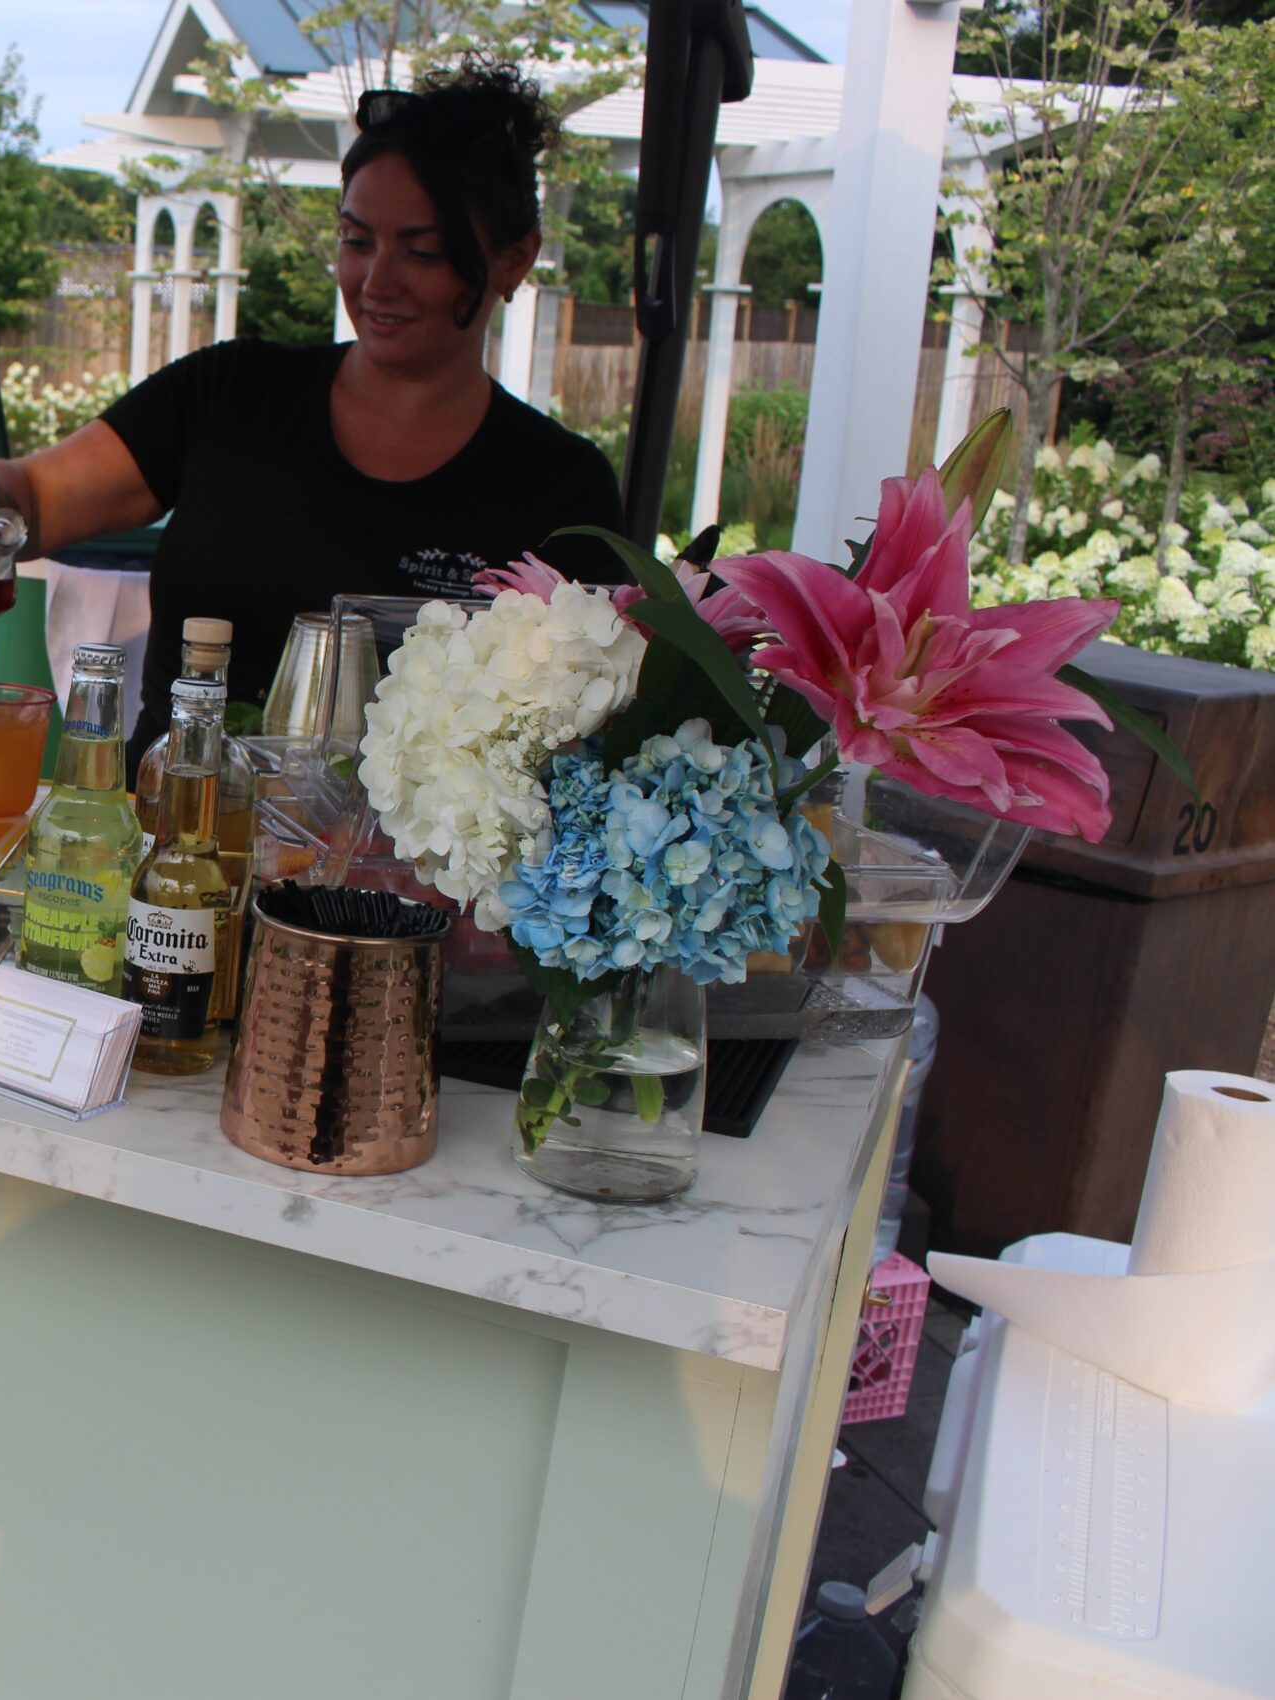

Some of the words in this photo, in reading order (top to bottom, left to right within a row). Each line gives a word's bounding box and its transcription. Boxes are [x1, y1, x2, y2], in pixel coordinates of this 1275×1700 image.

[398, 556, 443, 577] Spirit
[447, 567, 458, 580] &
[1172, 801, 1217, 855] 20
[27, 870, 104, 903] Seagram's
[37, 891, 80, 906] escapes
[127, 915, 207, 950] Coronita
[139, 944, 177, 965] Extra
[142, 976, 168, 986] CERVEZA
